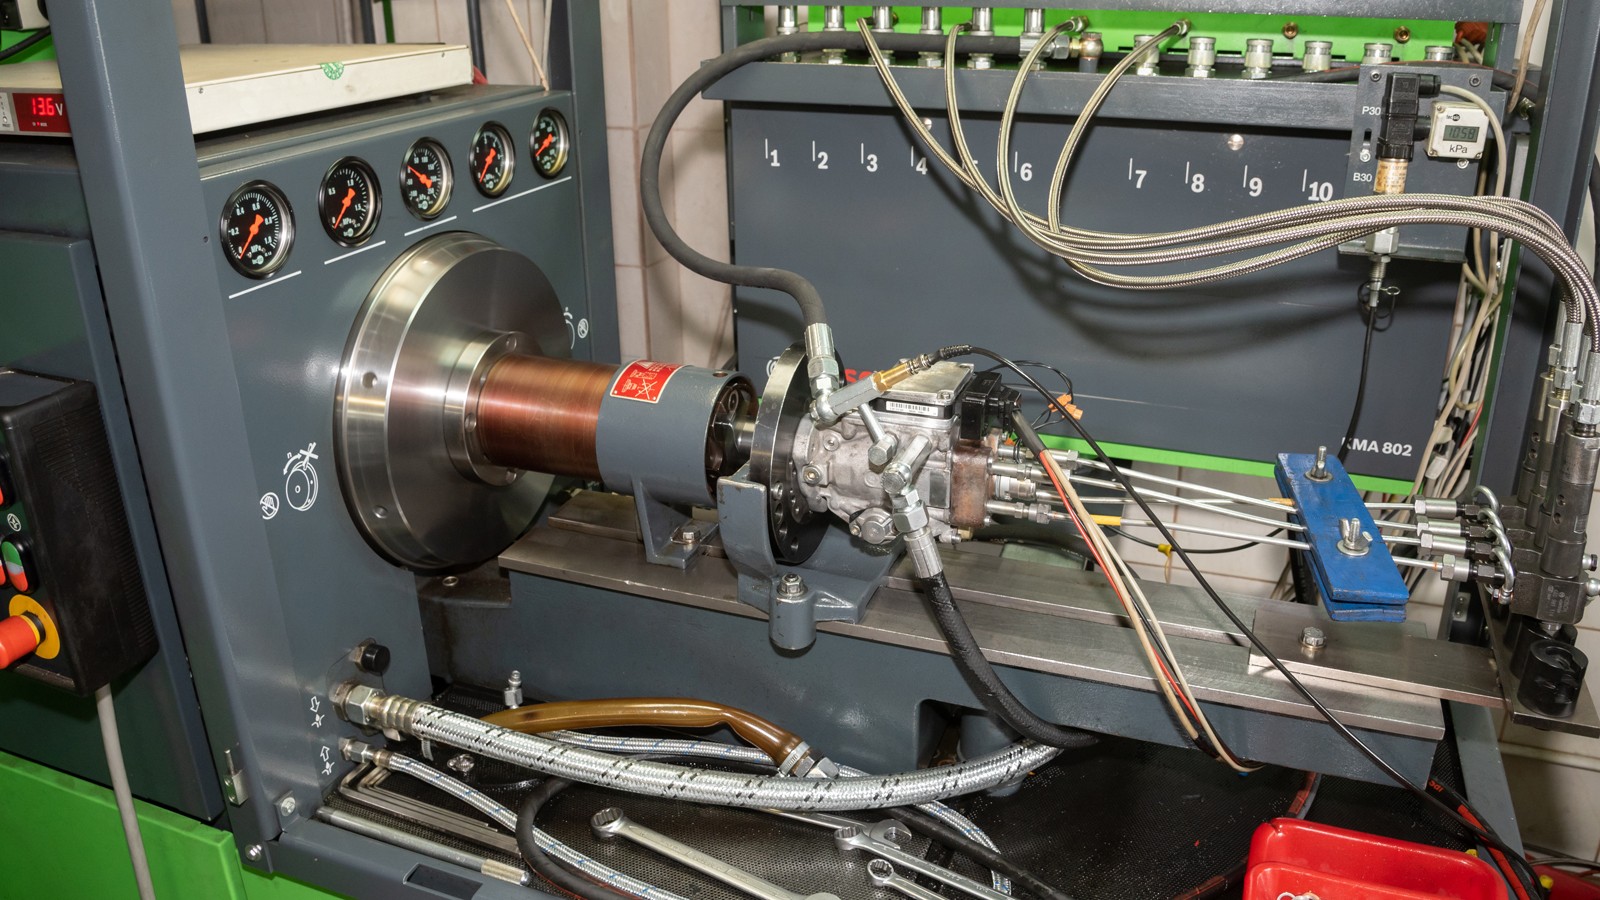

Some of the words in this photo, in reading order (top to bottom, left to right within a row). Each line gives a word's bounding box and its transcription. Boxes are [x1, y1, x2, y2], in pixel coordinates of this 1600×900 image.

[55, 103, 63, 116] V
[1361, 106, 1381, 116] P30
[1449, 144, 1468, 154] kPa
[770, 149, 781, 167] 1
[817, 151, 829, 170] 2
[866, 154, 878, 173] 3
[915, 157, 928, 175] 4
[1020, 162, 1033, 182] 6
[1353, 172, 1373, 182] B30
[347, 179, 355, 187] 1.0
[1135, 169, 1147, 189] 7
[1191, 173, 1205, 193] 8
[328, 187, 336, 196] 0.5
[1249, 177, 1263, 197] 9
[1308, 181, 1334, 201] 10
[236, 207, 245, 216] 0.4
[251, 202, 261, 211] 0.6
[354, 203, 362, 212] 1.5
[264, 216, 273, 226] 0.8
[230, 226, 240, 236] 0.2
[264, 235, 273, 245] 1.0
[1381, 441, 1413, 457] 802
